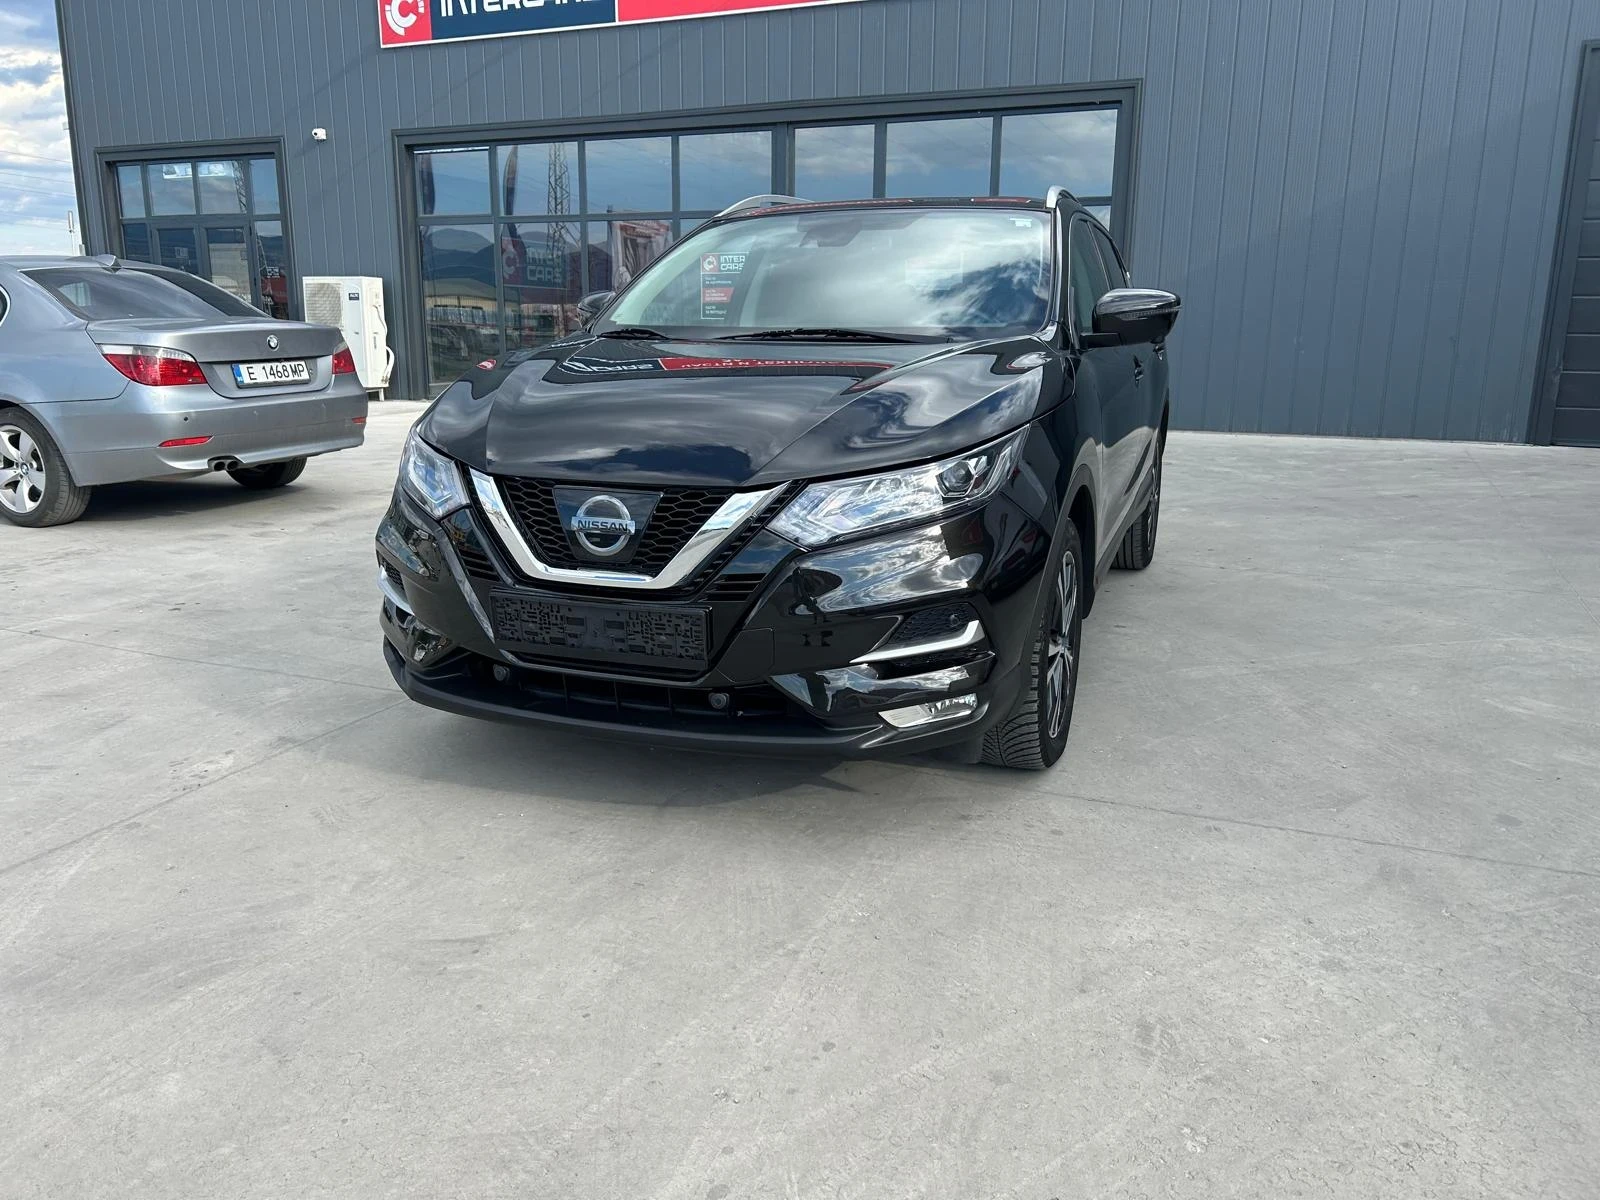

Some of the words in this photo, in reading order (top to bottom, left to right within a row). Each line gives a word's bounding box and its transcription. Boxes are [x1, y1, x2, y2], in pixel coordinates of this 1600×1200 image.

[720, 255, 746, 263] INTER
[246, 366, 257, 380] E
[577, 519, 628, 532] NISSAN
